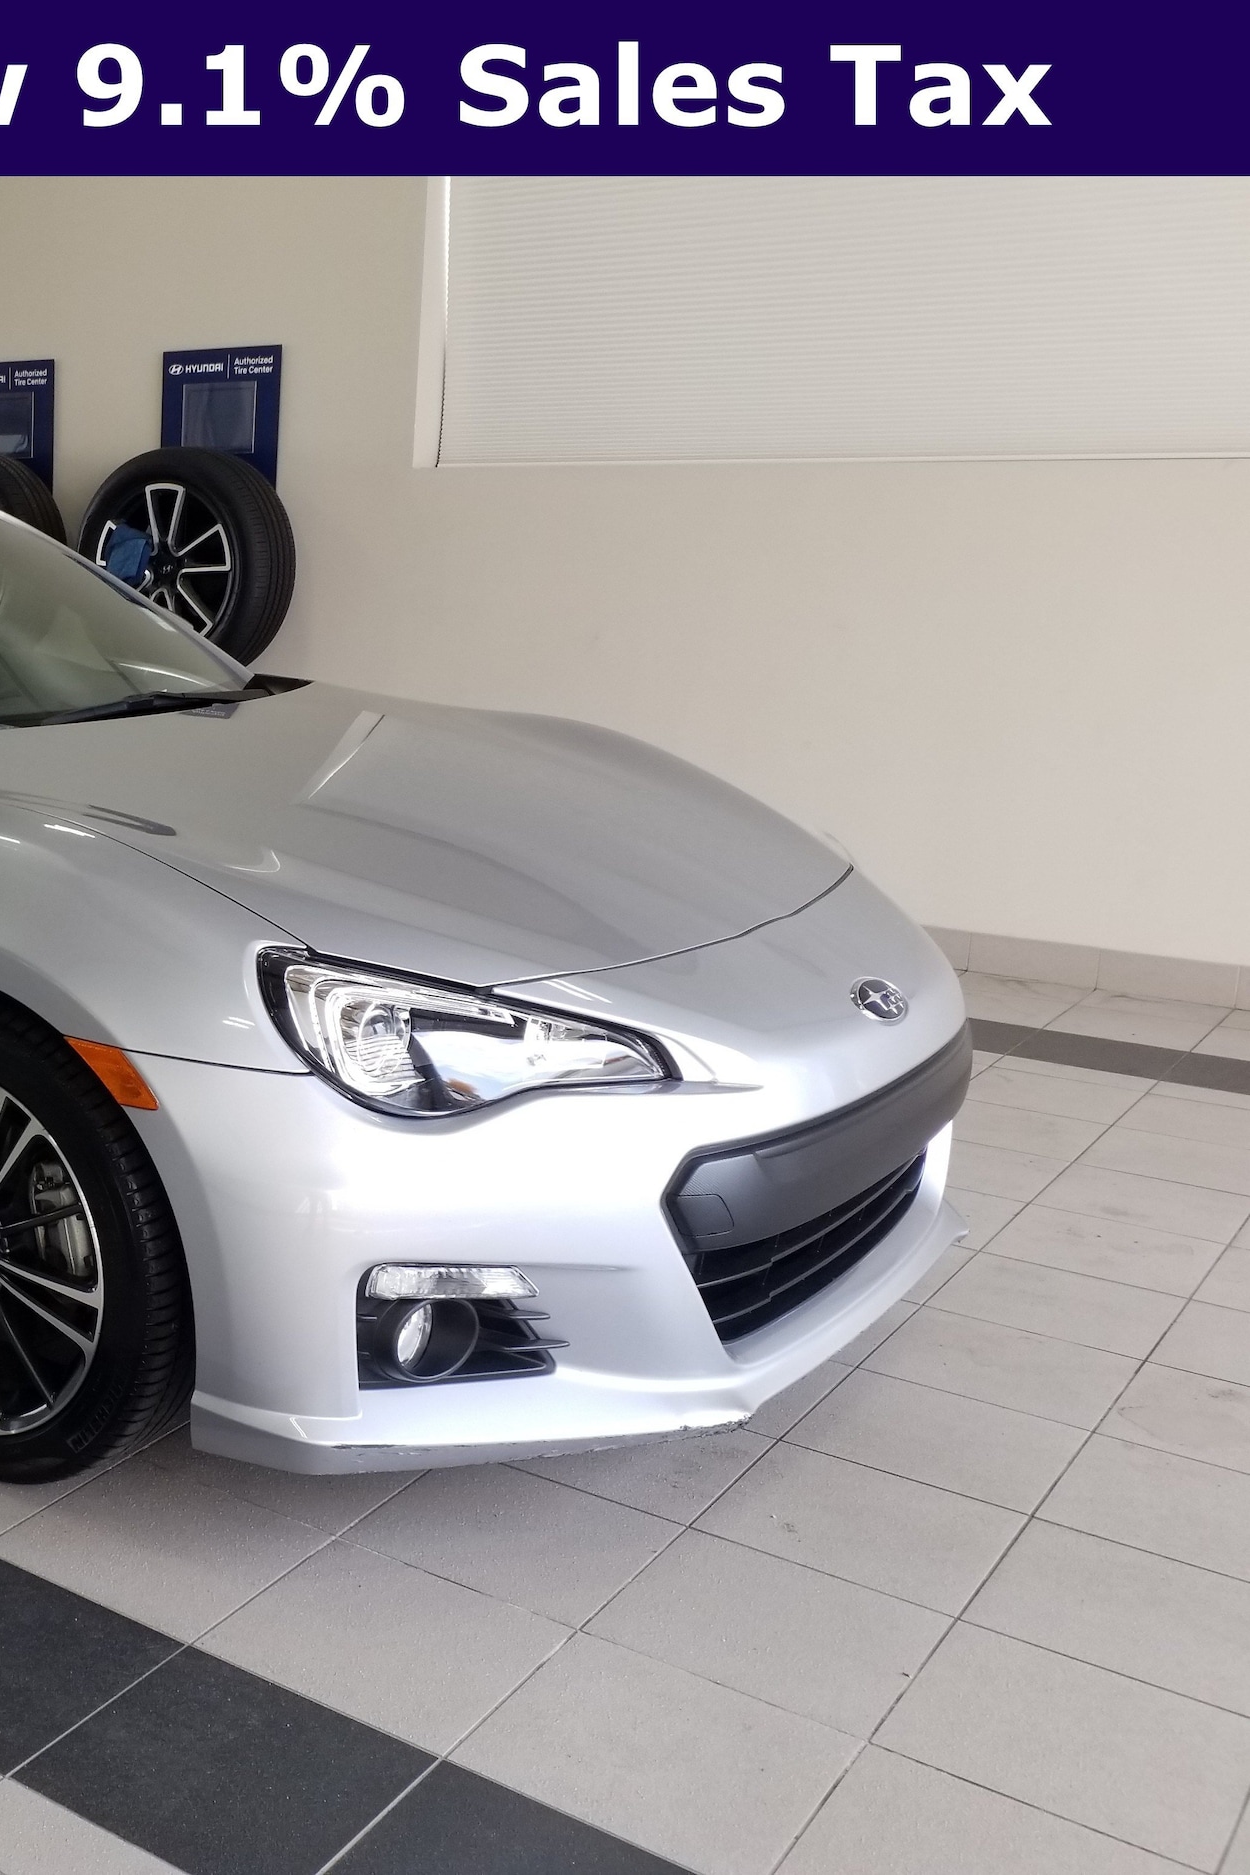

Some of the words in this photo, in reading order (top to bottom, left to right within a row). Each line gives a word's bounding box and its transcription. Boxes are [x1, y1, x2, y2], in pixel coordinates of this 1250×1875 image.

[233, 355, 274, 366] Authorized
[14, 368, 48, 378] Authorized
[185, 363, 224, 374] HYUNDAI
[233, 367, 248, 375] Tire
[248, 365, 273, 374] Center
[14, 379, 26, 387] Tire
[26, 378, 48, 386] Center
